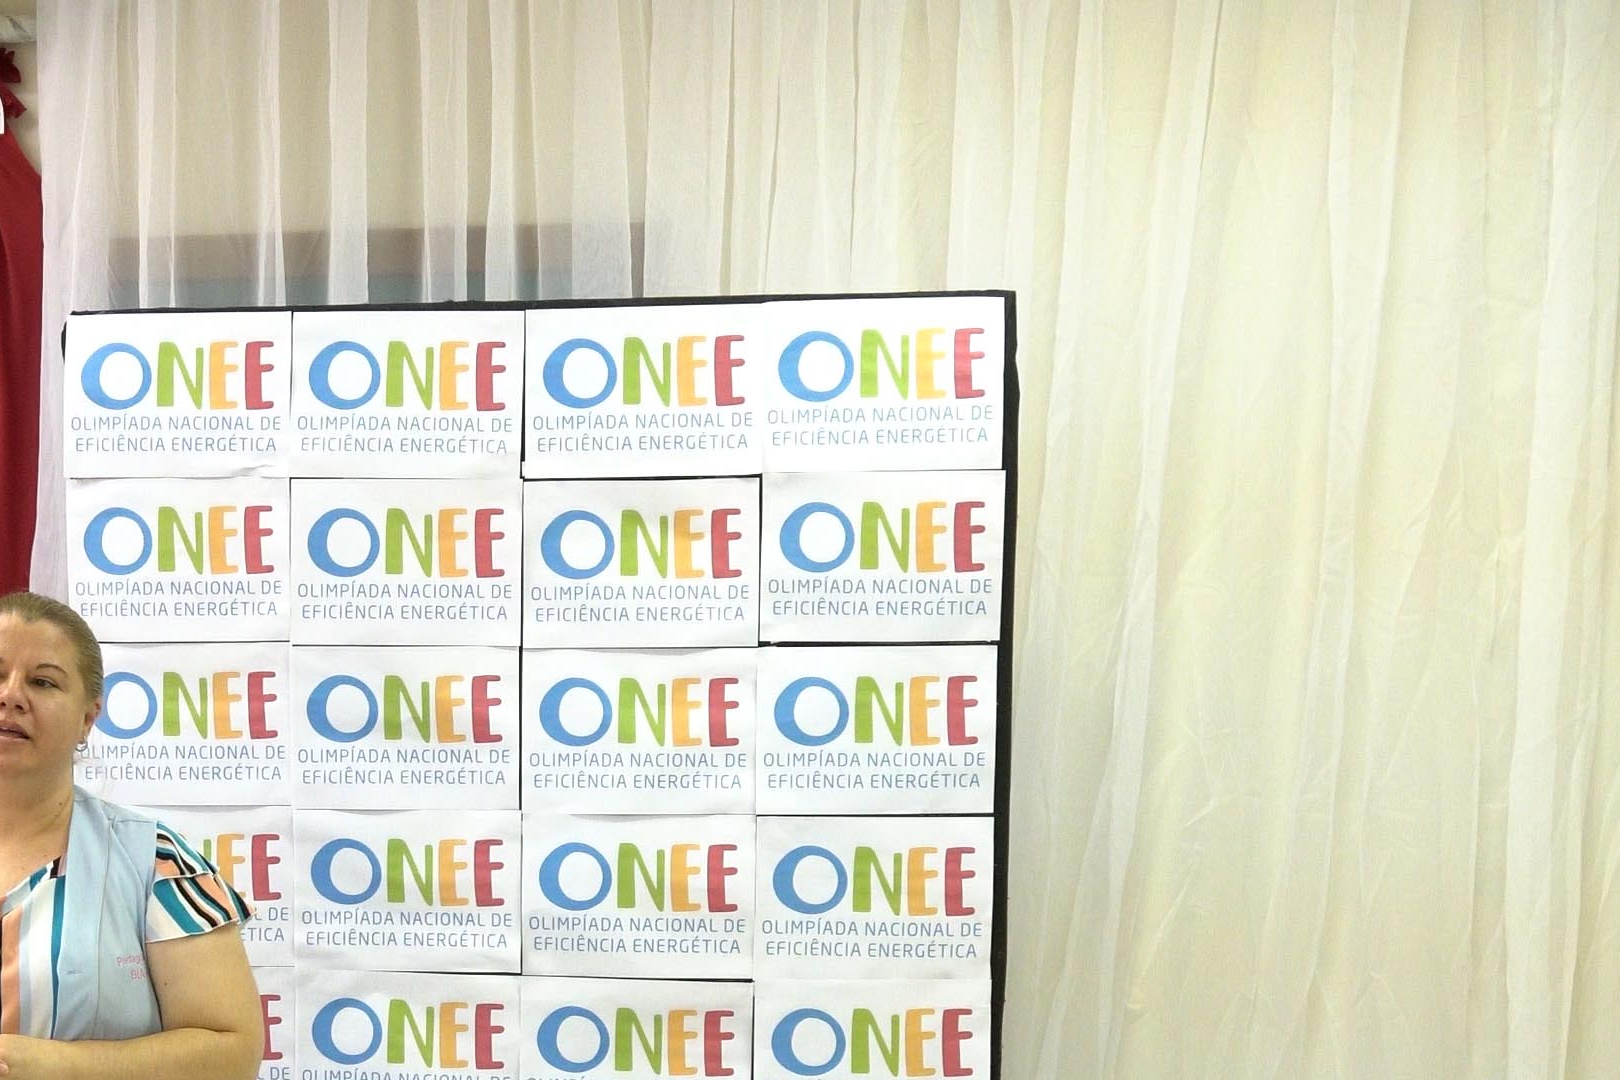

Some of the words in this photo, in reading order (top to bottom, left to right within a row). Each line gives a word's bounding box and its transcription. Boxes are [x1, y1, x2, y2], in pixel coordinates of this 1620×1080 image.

[542, 336, 745, 409] ONEE
[777, 328, 985, 403] ONEE
[81, 341, 274, 410] ONEE
[308, 341, 506, 411] ONEE
[71, 413, 162, 431] OLIMPÍADA
[169, 416, 254, 431] NACIONAL
[261, 416, 281, 430] DE
[298, 413, 390, 430] OLIMPÍADA
[398, 416, 484, 432] NACIONAL
[492, 418, 512, 432] DE
[533, 411, 628, 430] OLIMPÍADA
[636, 413, 724, 428] NACIONAL
[732, 412, 752, 427] DE
[768, 408, 865, 424] OLIMPÍADA
[873, 407, 964, 422] NACIONAL
[972, 405, 992, 420] DE
[76, 434, 165, 452] EFICIÊNCIA
[172, 434, 276, 452] ENERGÉTICA
[301, 434, 393, 452] EFICIÊNCIA
[400, 435, 507, 454] ENERGÉTICA
[538, 433, 632, 452] EFICIÊNCIA
[639, 434, 747, 450] ENERGÉTICA
[773, 427, 868, 446] EFICIÊNCIA
[876, 428, 988, 444] ENERGÉTICA
[83, 506, 274, 576] ONEE
[307, 508, 505, 578] ONEE
[540, 509, 742, 580] ONEE
[779, 501, 985, 573] ONEE
[76, 578, 164, 596] OLIMPÍADA
[171, 580, 256, 596] NACIONAL
[261, 580, 282, 594] DE
[298, 580, 391, 598] OLIMPÍADA
[398, 584, 484, 598] NACIONAL
[492, 584, 512, 599] DE
[531, 583, 626, 601] OLIMPÍADA
[633, 585, 721, 600] NACIONAL
[728, 585, 749, 599] DE
[768, 576, 866, 594] OLIMPÍADA
[873, 579, 964, 594] NACIONAL
[970, 579, 992, 593] DE
[81, 599, 168, 616] EFICIÊNCIA
[174, 598, 277, 616] ENERGÉTICA
[302, 602, 394, 619] EFICIÊNCIA
[401, 602, 507, 620] ENERGÉTICA
[536, 604, 629, 622] EFICIÊNCIA
[636, 603, 744, 621] ENERGÉTICA
[773, 597, 868, 616] EFICIÊNCIA
[876, 597, 987, 616] ENERGÉTICA
[95, 672, 280, 740] ONEE
[306, 675, 503, 744] ONEE
[539, 677, 740, 747] ONEE
[773, 676, 978, 747] ONEE
[81, 742, 169, 760] OLIMPÍADA
[175, 745, 260, 759] NACIONAL
[266, 745, 286, 759] DE
[298, 746, 391, 763] OLIMPÍADA
[397, 748, 483, 764] NACIONAL
[489, 749, 510, 764] DE
[530, 749, 624, 767] OLIMPÍADA
[631, 752, 719, 768] NACIONAL
[725, 753, 747, 767] DE
[764, 749, 860, 767] OLIMPÍADA
[868, 752, 958, 767] NACIONAL
[964, 752, 985, 767] DE
[85, 763, 172, 780] EFICIÊNCIA
[179, 763, 281, 781] ENERGÉTICA
[303, 766, 394, 784] EFICIÊNCIA
[401, 767, 505, 784] ENERGÉTICA
[534, 770, 627, 788] EFICIÊNCIA
[634, 771, 741, 789] ENERGÉTICA
[768, 771, 864, 789] EFICIÊNCIA
[870, 770, 980, 789] ENERGÉTICA
[310, 839, 504, 907] ONEE
[538, 843, 738, 913] ONEE
[772, 846, 975, 917] ONEE
[268, 907, 288, 921] DE
[301, 907, 394, 926] OLIMPÍADA
[400, 912, 486, 927] NACIONAL
[491, 913, 512, 927] DE
[528, 911, 624, 932] OLIMPÍADA
[630, 917, 719, 933] NACIONAL
[724, 918, 746, 933] DE
[762, 917, 859, 936] OLIMPÍADA
[865, 922, 954, 938] NACIONAL
[961, 923, 982, 939] DE
[306, 928, 398, 946] EFICIÊNCIA
[403, 930, 507, 948] ENERGÉTICA
[533, 935, 626, 952] EFICIÊNCIA
[633, 935, 740, 954] ENERGÉTICA
[766, 938, 861, 957] EFICIÊNCIA
[868, 939, 977, 960] ENERGÉTICA
[312, 998, 504, 1069] ONEE
[536, 1007, 735, 1077] ONEE
[771, 1008, 974, 1078] ONEE
